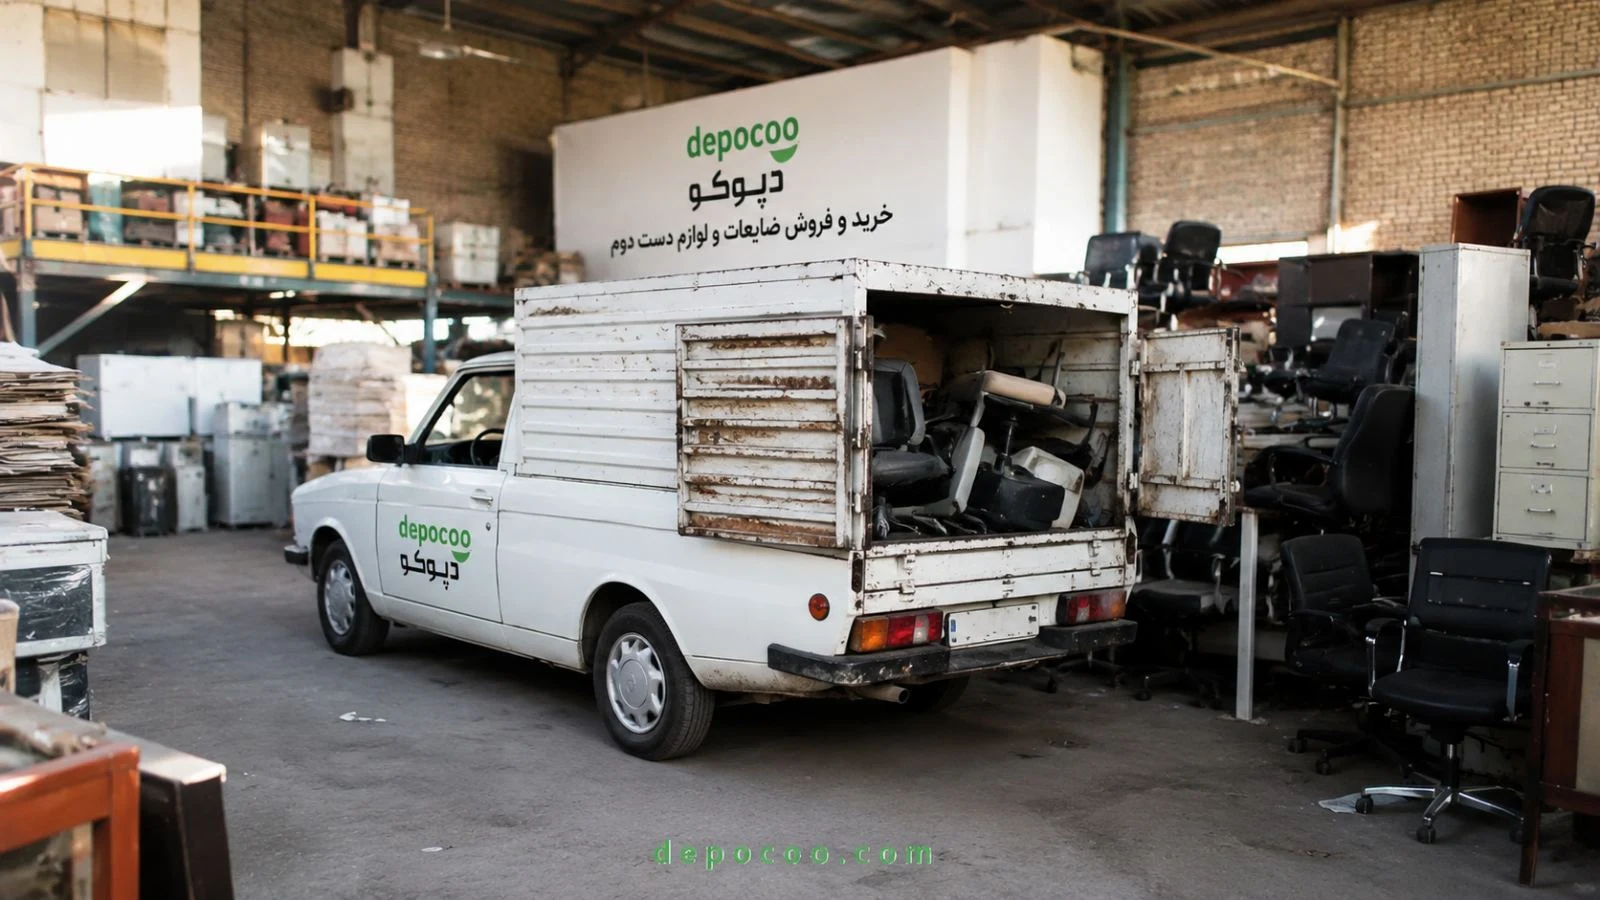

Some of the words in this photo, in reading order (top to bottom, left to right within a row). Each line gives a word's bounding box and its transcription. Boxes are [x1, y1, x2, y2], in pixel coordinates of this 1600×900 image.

[687, 116, 799, 162] depocoo
[688, 169, 784, 211] دپوکو
[723, 217, 781, 244] ضایعات
[785, 208, 833, 240] فروش
[838, 217, 847, 236] و
[852, 204, 893, 232] خرید
[610, 236, 634, 257] دوم
[638, 232, 673, 250] دست
[677, 223, 708, 252] لوازم
[712, 230, 720, 246] و
[399, 514, 471, 548] depocoo
[400, 549, 459, 591] دپوکو
